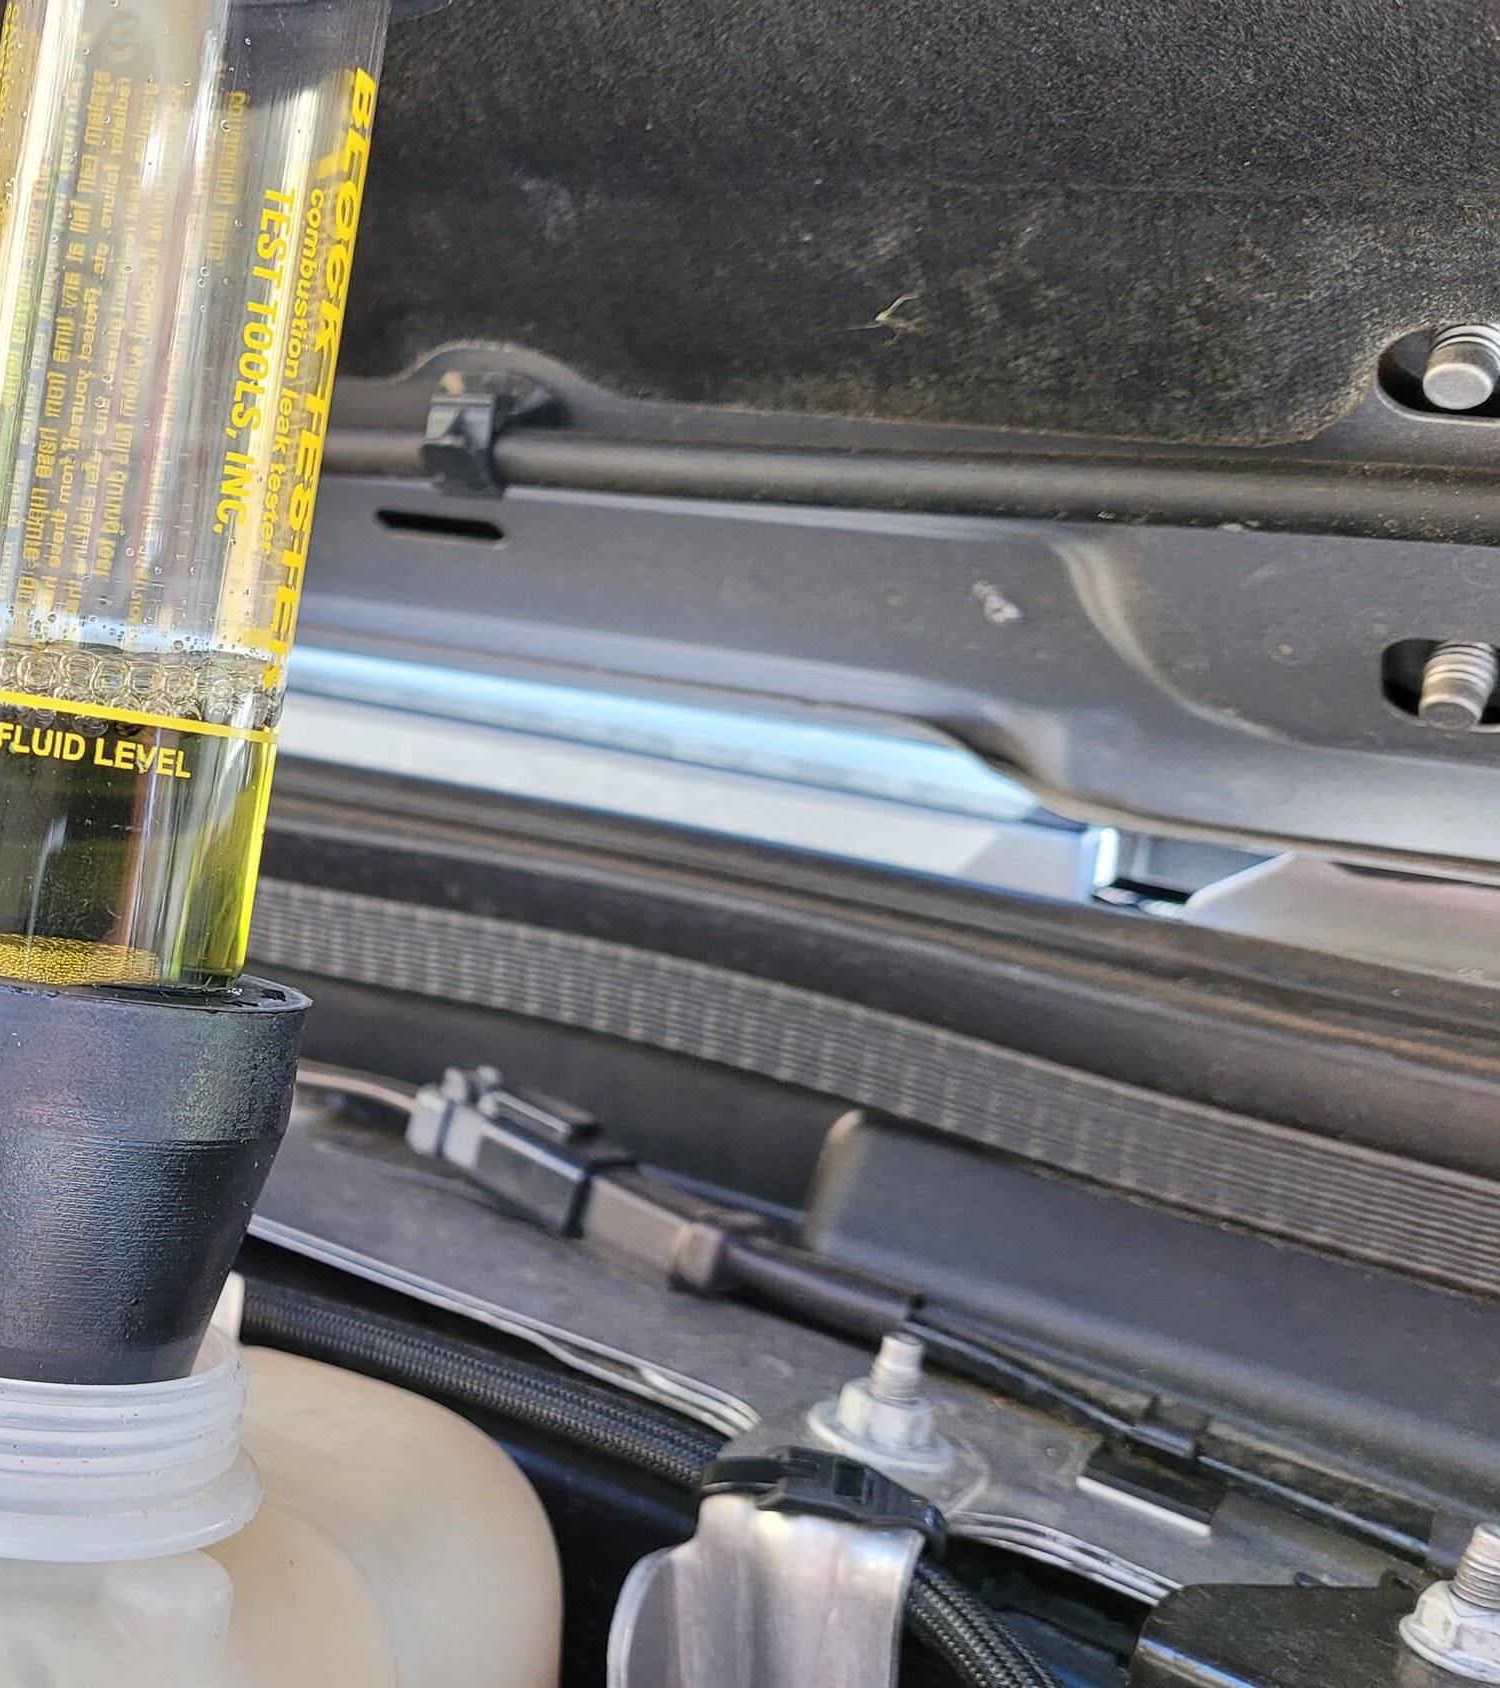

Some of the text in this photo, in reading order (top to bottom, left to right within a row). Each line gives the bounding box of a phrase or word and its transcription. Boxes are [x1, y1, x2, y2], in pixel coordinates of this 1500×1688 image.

[213, 188, 296, 534] TEST TOOLS, INC.
[315, 67, 376, 353] BLOCK
[260, 188, 325, 553] combustion leak tester
[94, 737, 192, 779] LEVEL
